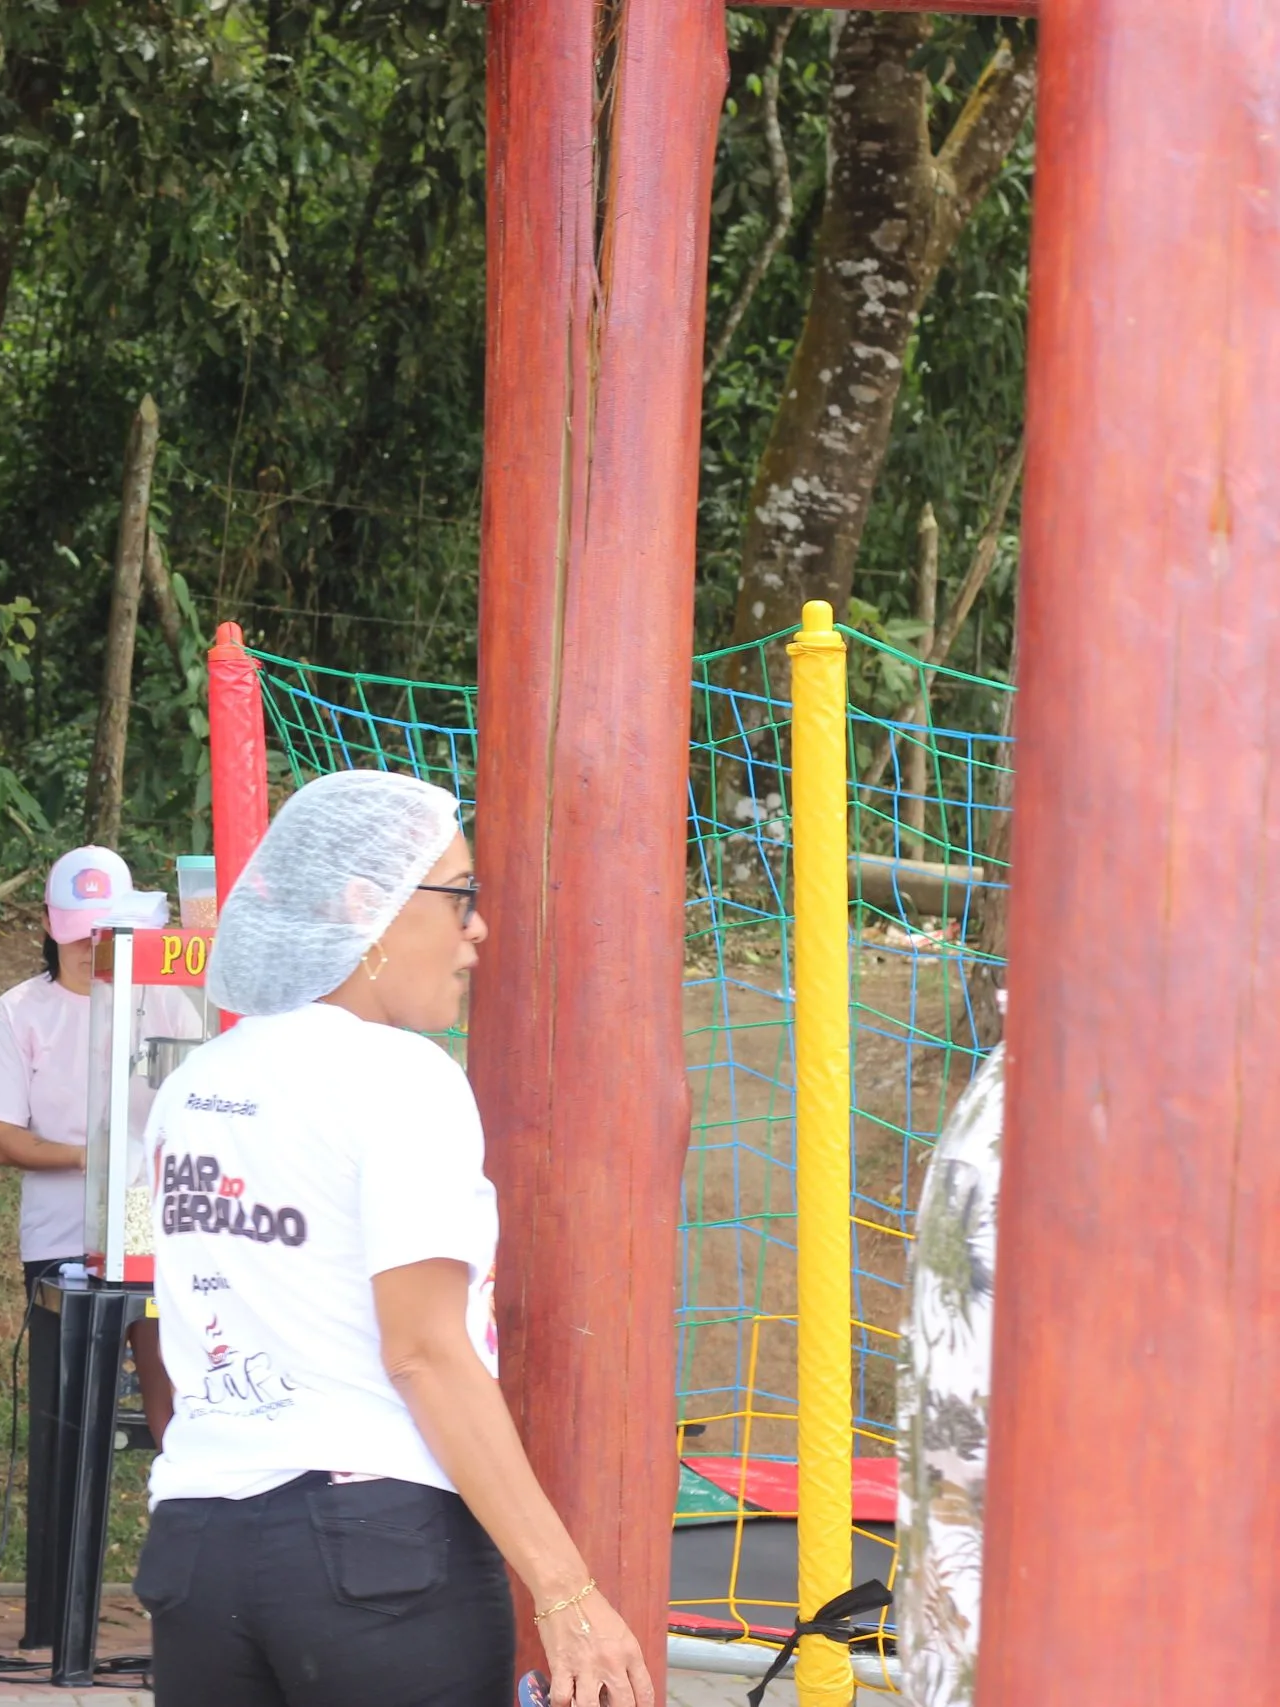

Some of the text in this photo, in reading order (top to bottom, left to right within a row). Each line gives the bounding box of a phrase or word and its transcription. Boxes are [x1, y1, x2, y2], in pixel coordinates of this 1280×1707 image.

[160, 935, 215, 976] PO
[163, 1153, 220, 1194] BAR
[162, 1193, 308, 1247] GERALDO
